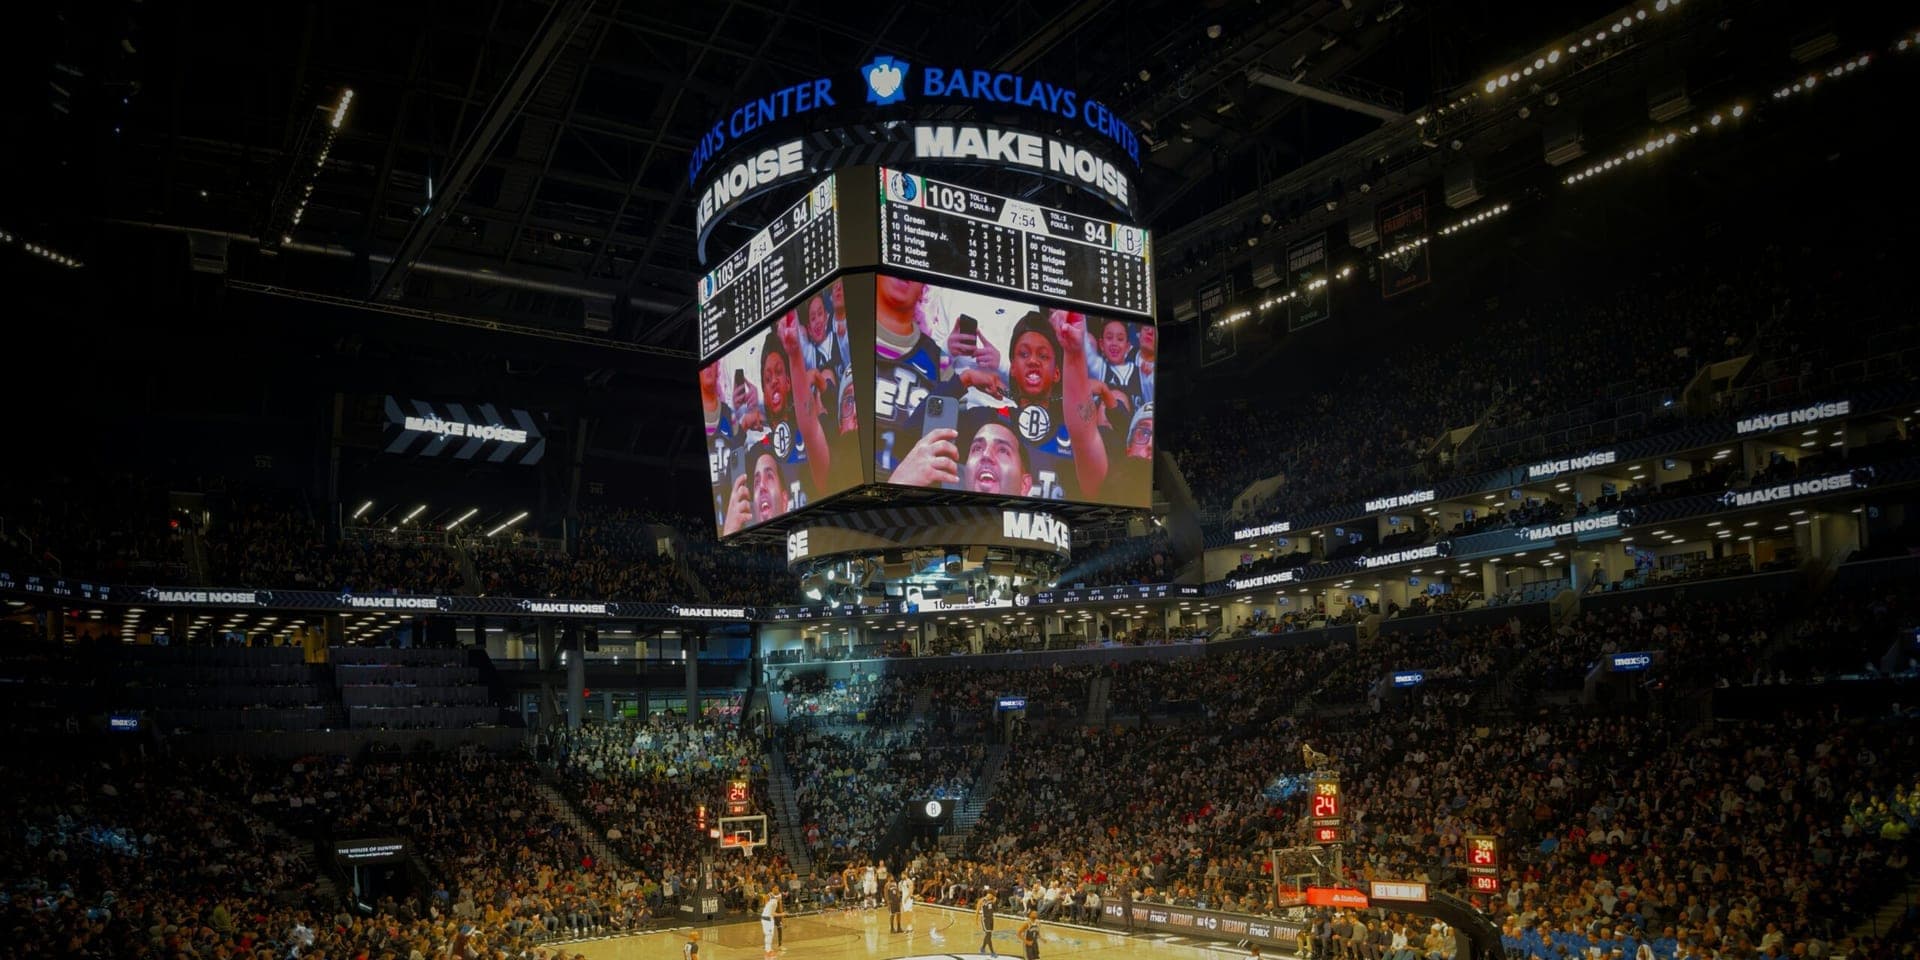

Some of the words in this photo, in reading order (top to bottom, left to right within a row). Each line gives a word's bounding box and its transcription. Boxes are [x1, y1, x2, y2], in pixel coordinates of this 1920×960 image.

[730, 78, 836, 139] CENTER
[924, 67, 1077, 118] BARCLAYS
[1084, 98, 1140, 168] CENTER
[714, 140, 804, 210] NOISE
[915, 126, 1043, 168] MAKE
[1049, 140, 1128, 206] NOISE
[929, 185, 966, 212] 103
[793, 202, 808, 229] 94
[903, 214, 926, 226] Green
[1010, 212, 1036, 228] 7:54
[904, 224, 939, 240] Hardaway
[904, 234, 925, 248] Irving
[1084, 222, 1107, 244] 94
[904, 245, 928, 257] Kleber
[1042, 254, 1066, 267] Bridges
[905, 256, 930, 268] Doncic
[1042, 264, 1064, 275] Wilson
[717, 261, 734, 288] 103
[1736, 413, 1789, 434] MAKE
[1791, 401, 1849, 423] NOISE
[404, 417, 464, 436] MAKE
[466, 423, 527, 443] NOISE
[1529, 458, 1569, 477] MAKE
[1570, 450, 1616, 470] NOISE
[1736, 486, 1791, 506] MAKE
[1793, 475, 1852, 496] NOISE
[1365, 498, 1398, 512] MAKE
[1399, 490, 1434, 507] NOISE
[1003, 511, 1070, 550] MAKE
[1234, 528, 1260, 540] MAKE
[1260, 522, 1290, 536] NOISE
[1529, 522, 1572, 540] MAKE
[1573, 514, 1618, 533] NOISE
[1366, 554, 1400, 568] MAKE
[1401, 546, 1438, 564] NOISE
[1236, 578, 1262, 590] MAKE
[1263, 571, 1293, 585] NOISE
[159, 592, 207, 602] MAKE
[209, 593, 256, 603] NOISE
[351, 597, 398, 607] MAKE
[400, 598, 437, 609] NOISE
[531, 602, 569, 613] MAKE
[570, 603, 606, 614] NOISE
[679, 607, 712, 616] MAKE
[713, 608, 745, 618] NOISE
[731, 789, 745, 800] 24
[1316, 796, 1335, 816] 24
[1475, 850, 1491, 863] 24
[1249, 927, 1270, 937] max
